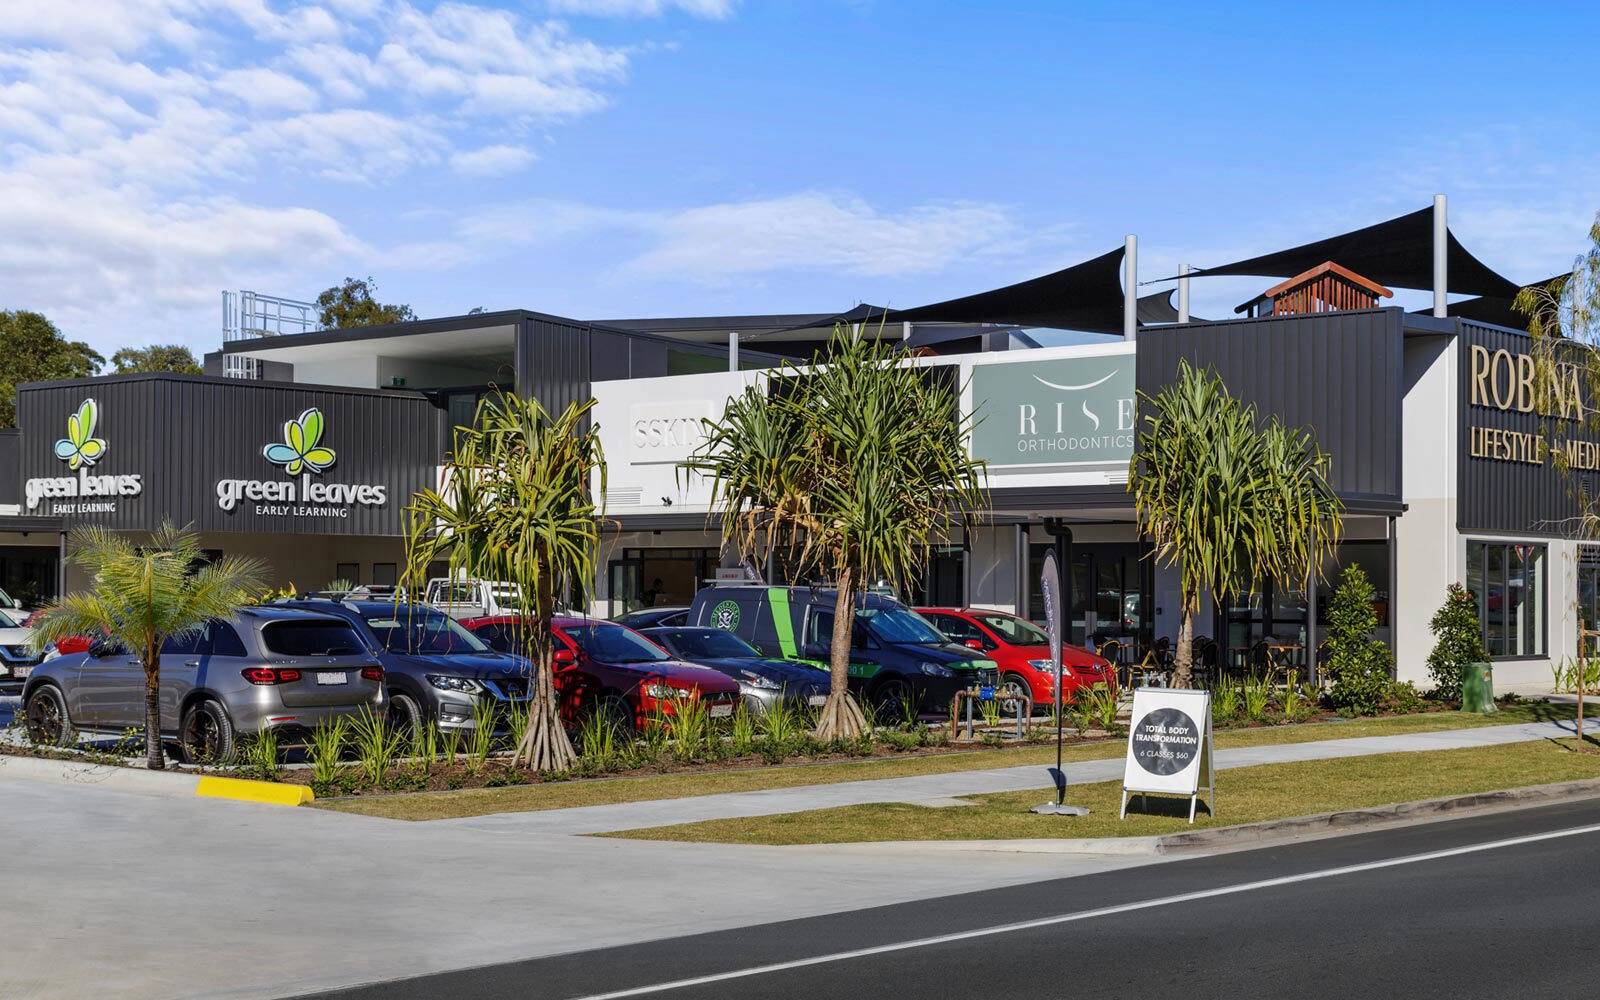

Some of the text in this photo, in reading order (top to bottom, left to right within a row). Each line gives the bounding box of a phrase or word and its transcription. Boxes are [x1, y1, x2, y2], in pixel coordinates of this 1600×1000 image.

[1018, 398, 1134, 435] RISE
[1017, 435, 1134, 452] ORTHODONTICS
[1471, 426, 1544, 464] LIFESTYLE
[25, 467, 142, 509] green leaves
[216, 473, 386, 511] green leaves
[53, 502, 116, 514] EARLY LEARNING
[256, 505, 347, 518] EARLY LEARNING
[1145, 725, 1189, 735] TOTAL BODY
[1135, 733, 1197, 745] TRANSFORMATION
[1146, 750, 1175, 758] CLASSES
[1176, 751, 1189, 759] $60
